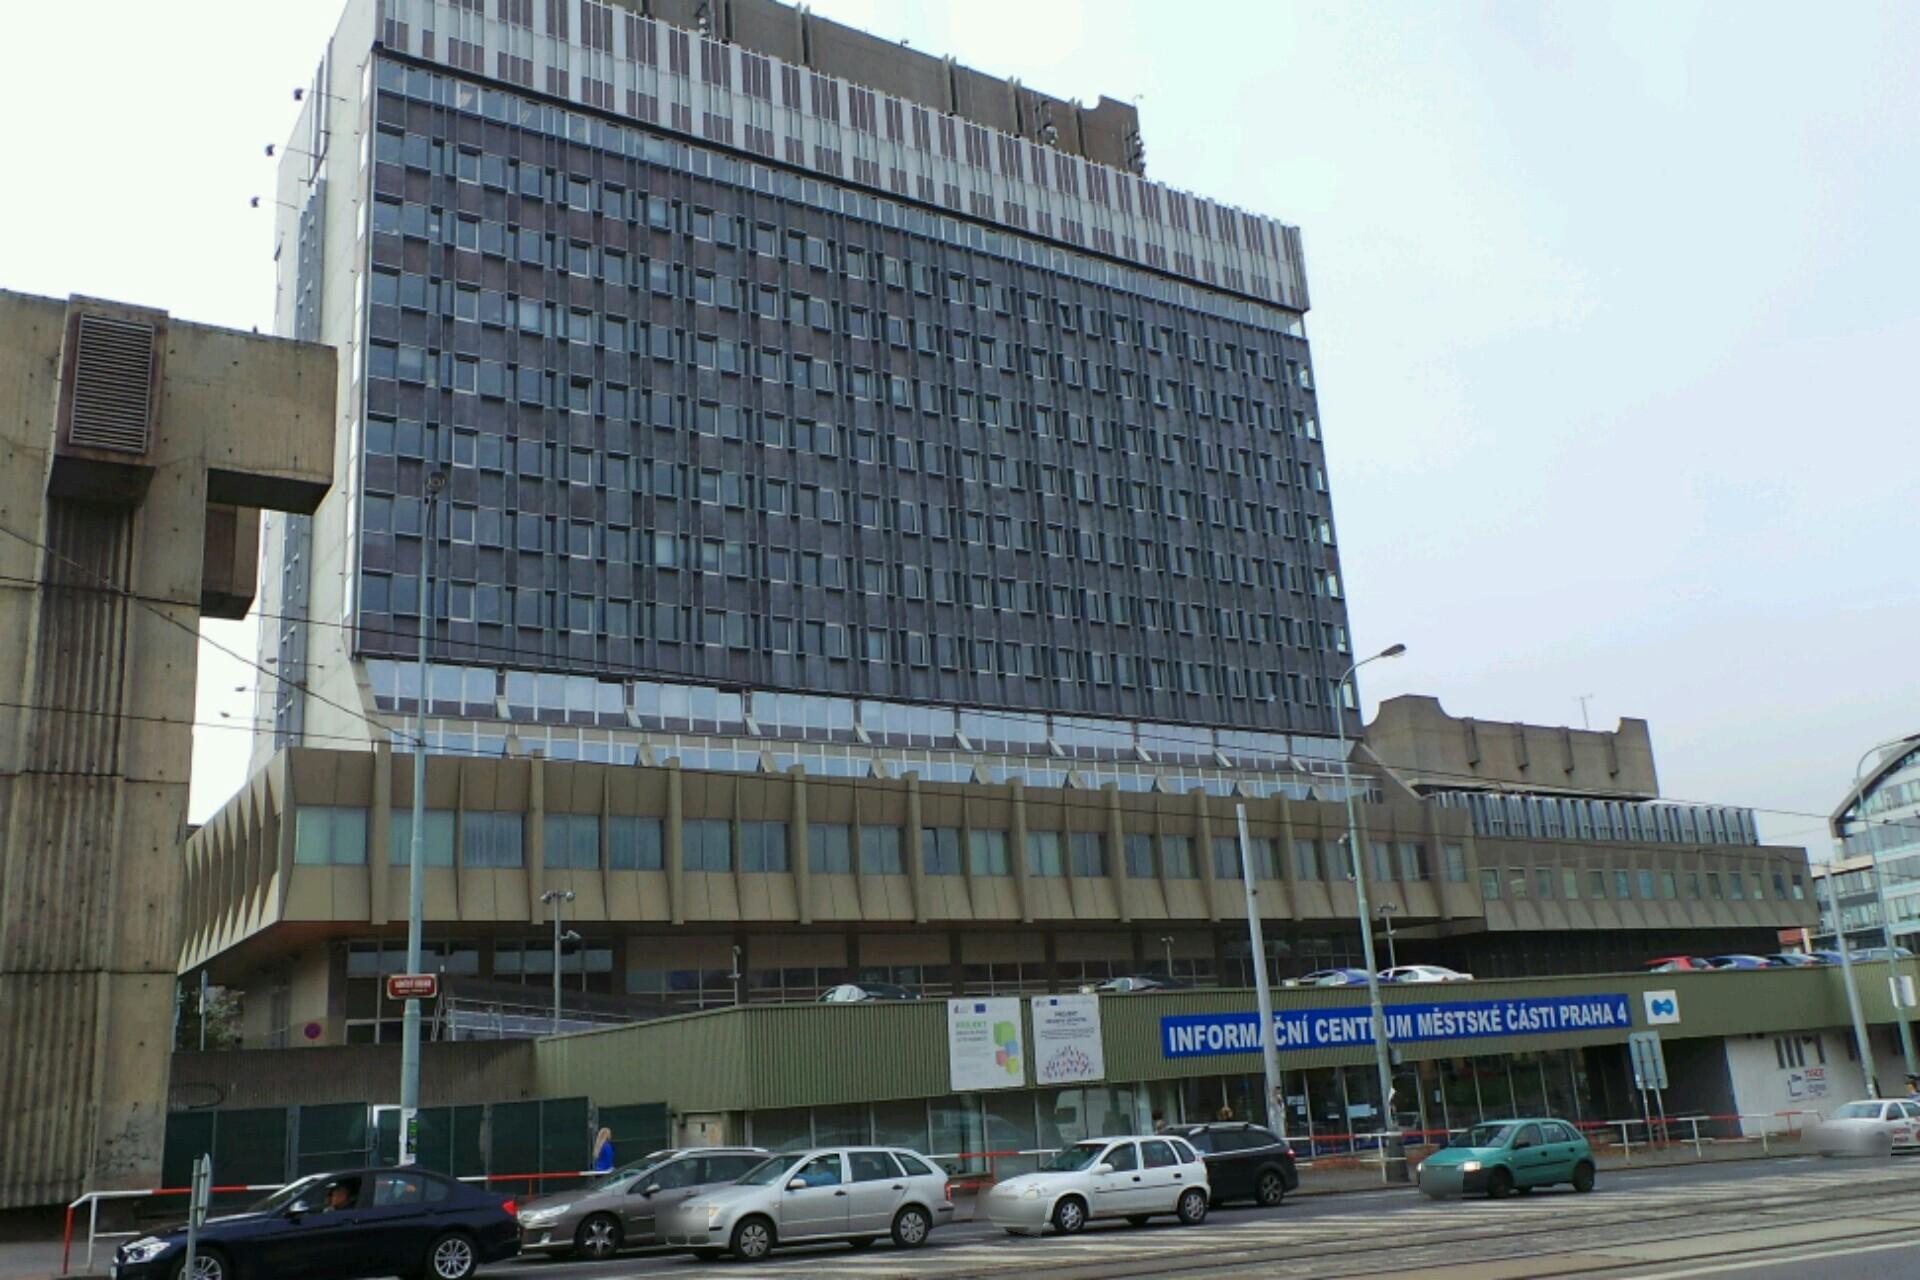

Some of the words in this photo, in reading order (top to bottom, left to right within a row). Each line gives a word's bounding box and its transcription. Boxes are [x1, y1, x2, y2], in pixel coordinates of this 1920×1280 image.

[1168, 1014, 1309, 1052] INFORMČNÍ
[1418, 1005, 1502, 1035] MĚSTSKÉ
[1507, 1003, 1556, 1030] ČÁSTI
[1559, 1003, 1614, 1027] PRAHA
[1617, 1002, 1627, 1023] 4
